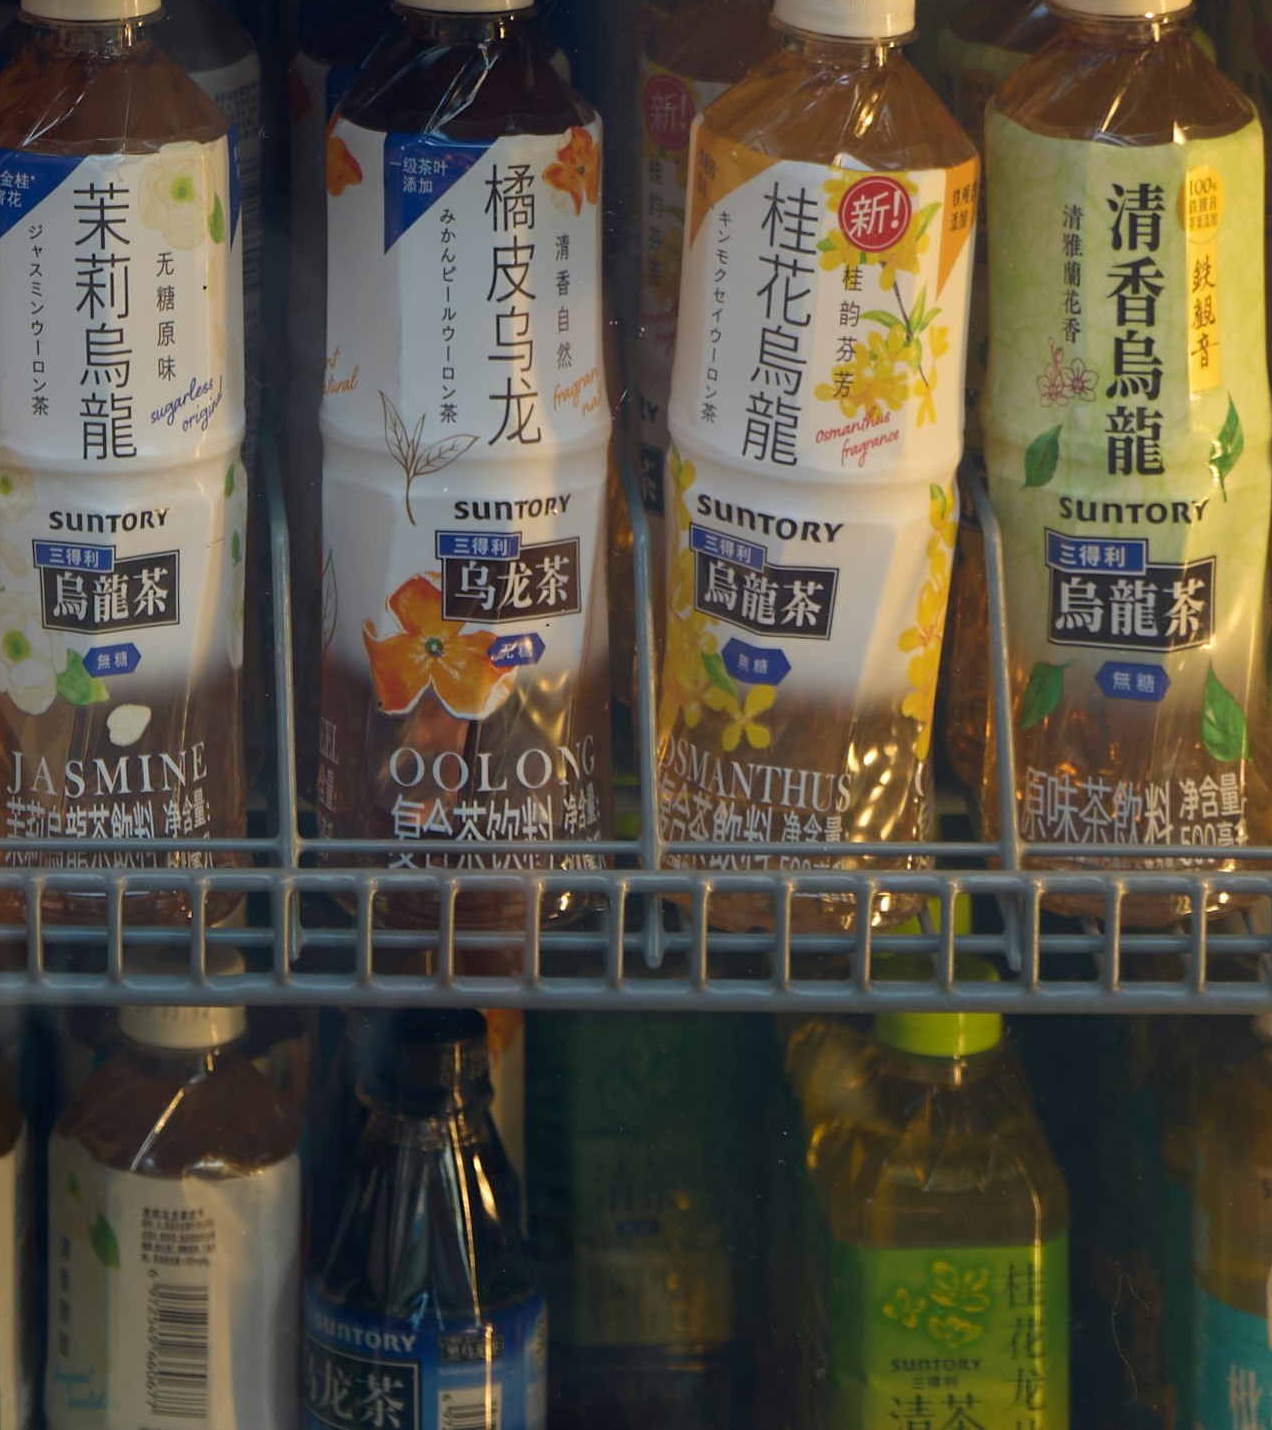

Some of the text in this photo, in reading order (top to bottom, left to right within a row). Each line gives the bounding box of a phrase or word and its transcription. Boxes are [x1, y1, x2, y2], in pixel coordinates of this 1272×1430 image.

[850, 191, 904, 239] 新!
[484, 163, 542, 448] 橘皮乌龙
[555, 232, 573, 370] 清香自然
[1062, 204, 1084, 345] 清雅蘭花香
[74, 180, 137, 463] 茉莉烏龍
[155, 250, 178, 382] 无糖原味
[439, 207, 459, 424] みかんピールウーロン茶
[741, 181, 819, 469] 桂花烏龍
[832, 264, 864, 401] 桂韵芬芳
[1105, 182, 1166, 478] 清香烏龍
[48, 508, 171, 535] SUNTORY
[453, 492, 572, 523] SUNTORY
[696, 491, 845, 544] SUNTORY
[1058, 494, 1210, 526] SUNTORY
[454, 556, 570, 612] 乌龙茶
[1058, 543, 1128, 571] 三得利
[51, 566, 171, 624] 烏龍茶
[702, 560, 828, 629] 烏龍茶
[1055, 575, 1206, 640] 烏龍茶
[1112, 669, 1156, 693] 無糖
[4, 741, 208, 799] JASMINE
[389, 734, 595, 791] OOLONG
[658, 736, 853, 815] OSMANTHUS
[1022, 766, 1174, 849] 原味茶飲料
